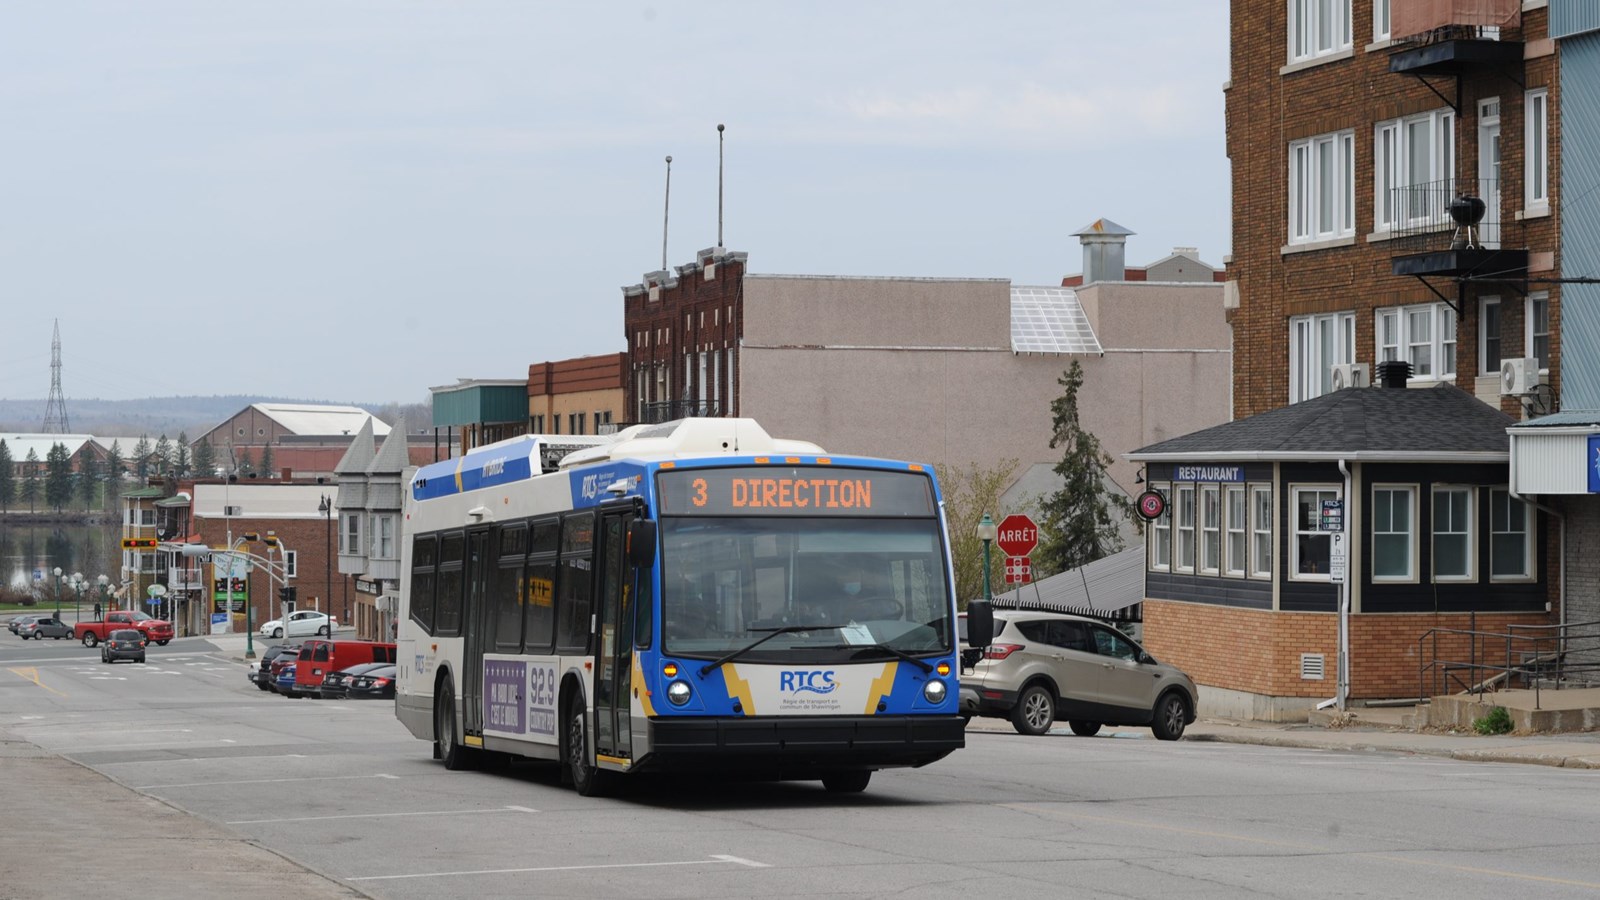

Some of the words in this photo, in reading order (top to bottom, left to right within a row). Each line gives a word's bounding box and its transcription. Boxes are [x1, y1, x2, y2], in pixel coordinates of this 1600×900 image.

[1178, 466, 1239, 481] RESTAURANT
[692, 478, 708, 507] 3
[732, 478, 871, 508] DIRECTION
[999, 527, 1036, 542] ARRÊT
[530, 667, 555, 706] 92.9
[780, 670, 838, 693] RTCS
